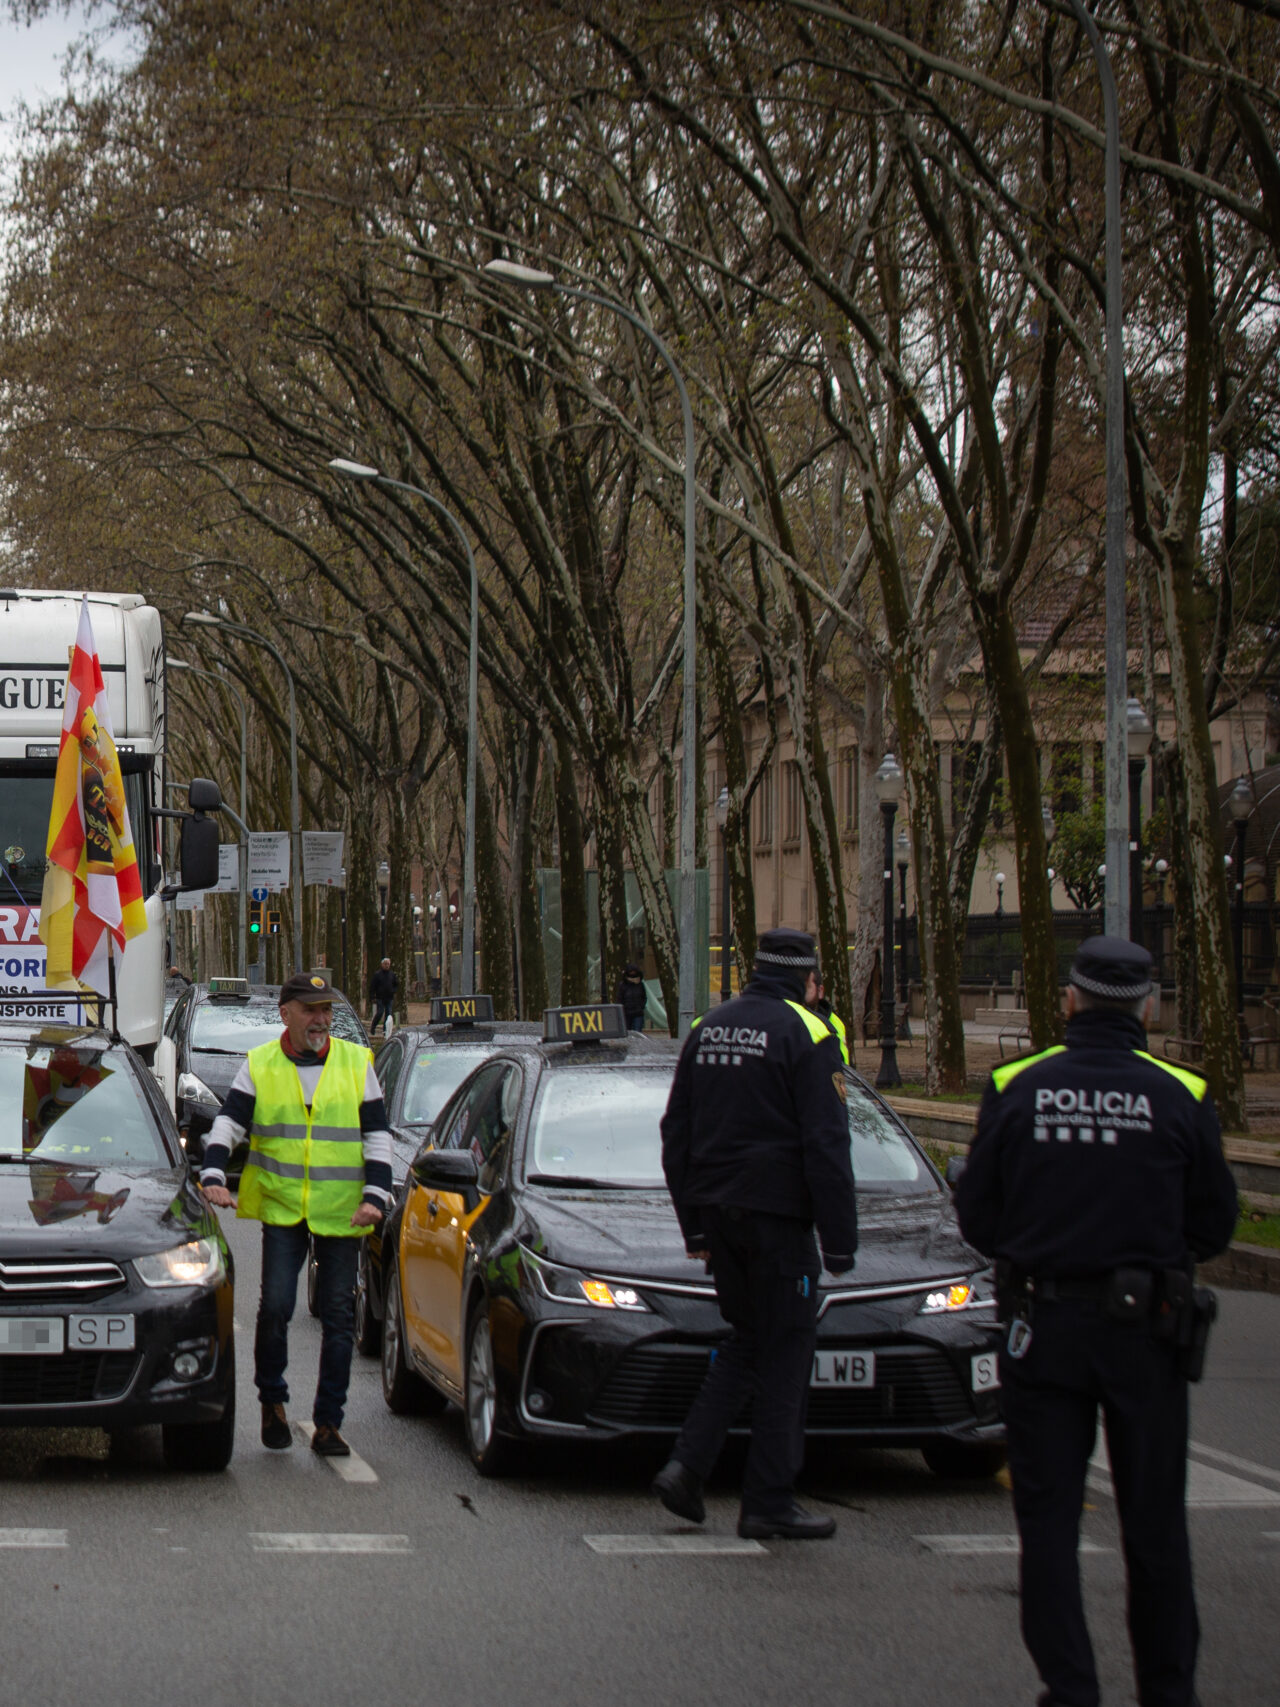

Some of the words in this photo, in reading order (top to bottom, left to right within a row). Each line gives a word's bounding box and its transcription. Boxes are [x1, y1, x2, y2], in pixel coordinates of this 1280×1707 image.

[443, 999, 477, 1018] TAXI
[560, 1010, 603, 1034] TAXI
[700, 1026, 768, 1048] POLICIA
[1035, 1088, 1153, 1119] POLICIA
[1095, 1114, 1153, 1132] urbana
[814, 1355, 867, 1383] LWB
[977, 1358, 992, 1385] S
